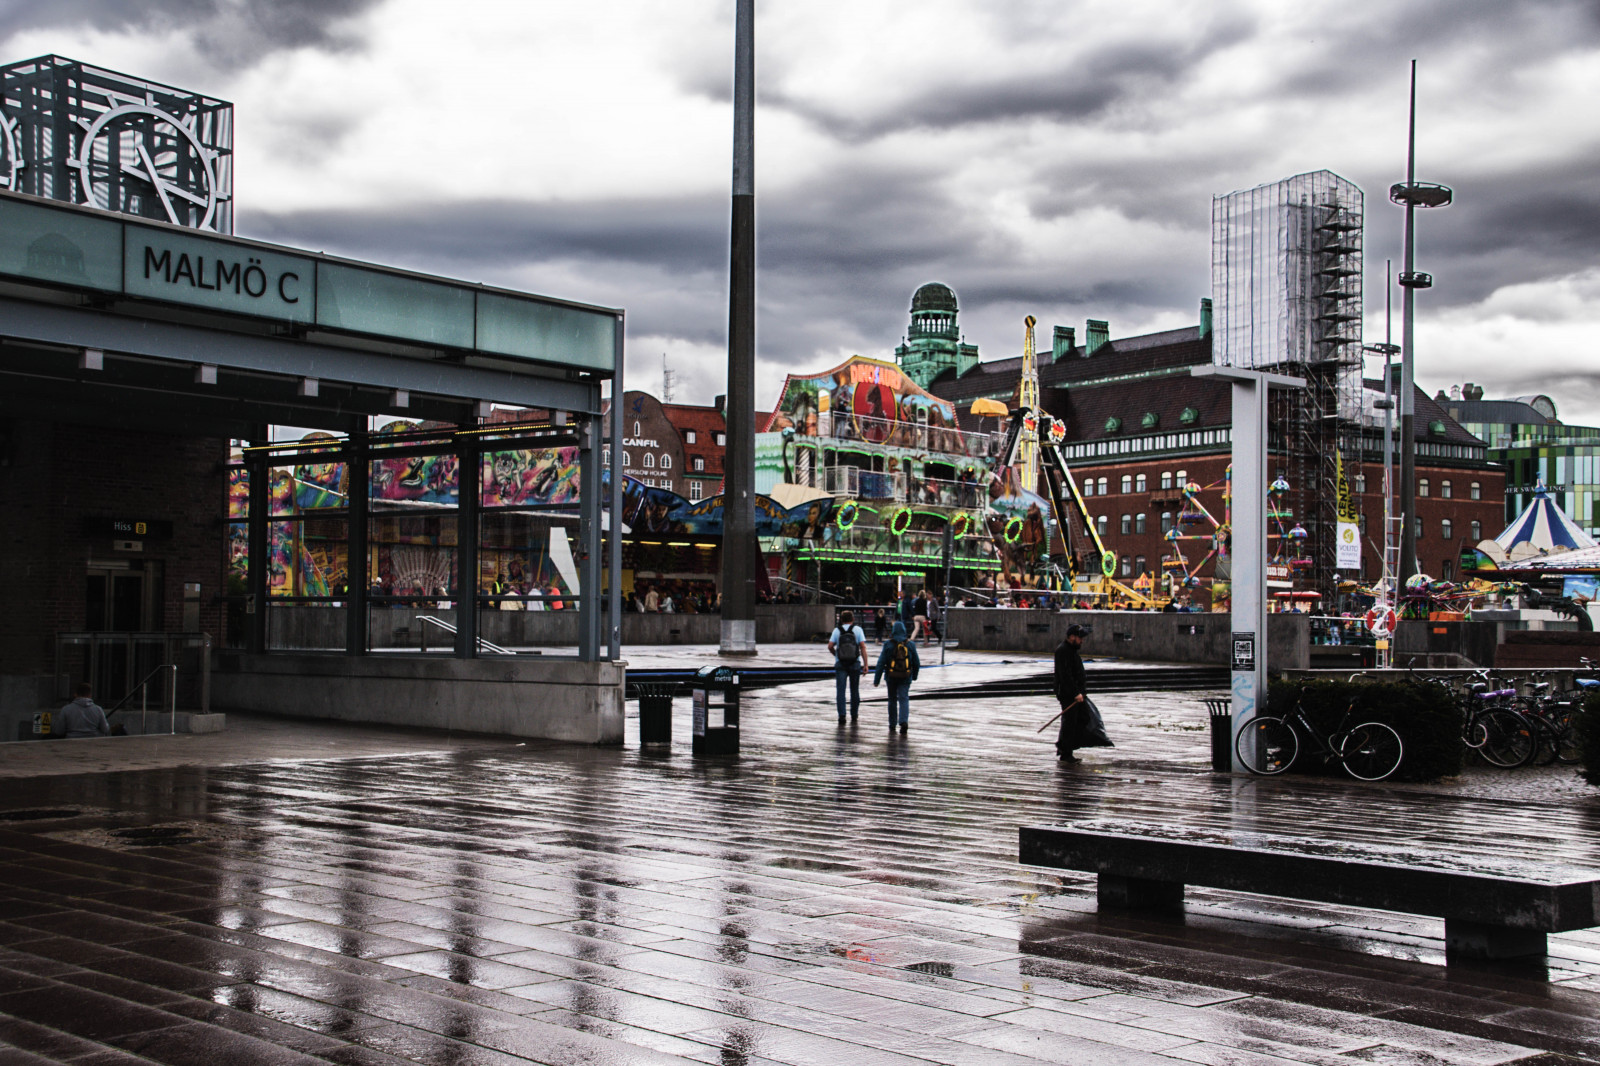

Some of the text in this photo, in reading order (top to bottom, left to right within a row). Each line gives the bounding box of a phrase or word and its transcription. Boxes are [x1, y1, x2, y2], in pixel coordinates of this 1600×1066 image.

[145, 246, 299, 304] MALMÖ C
[114, 521, 132, 531] Hiss
